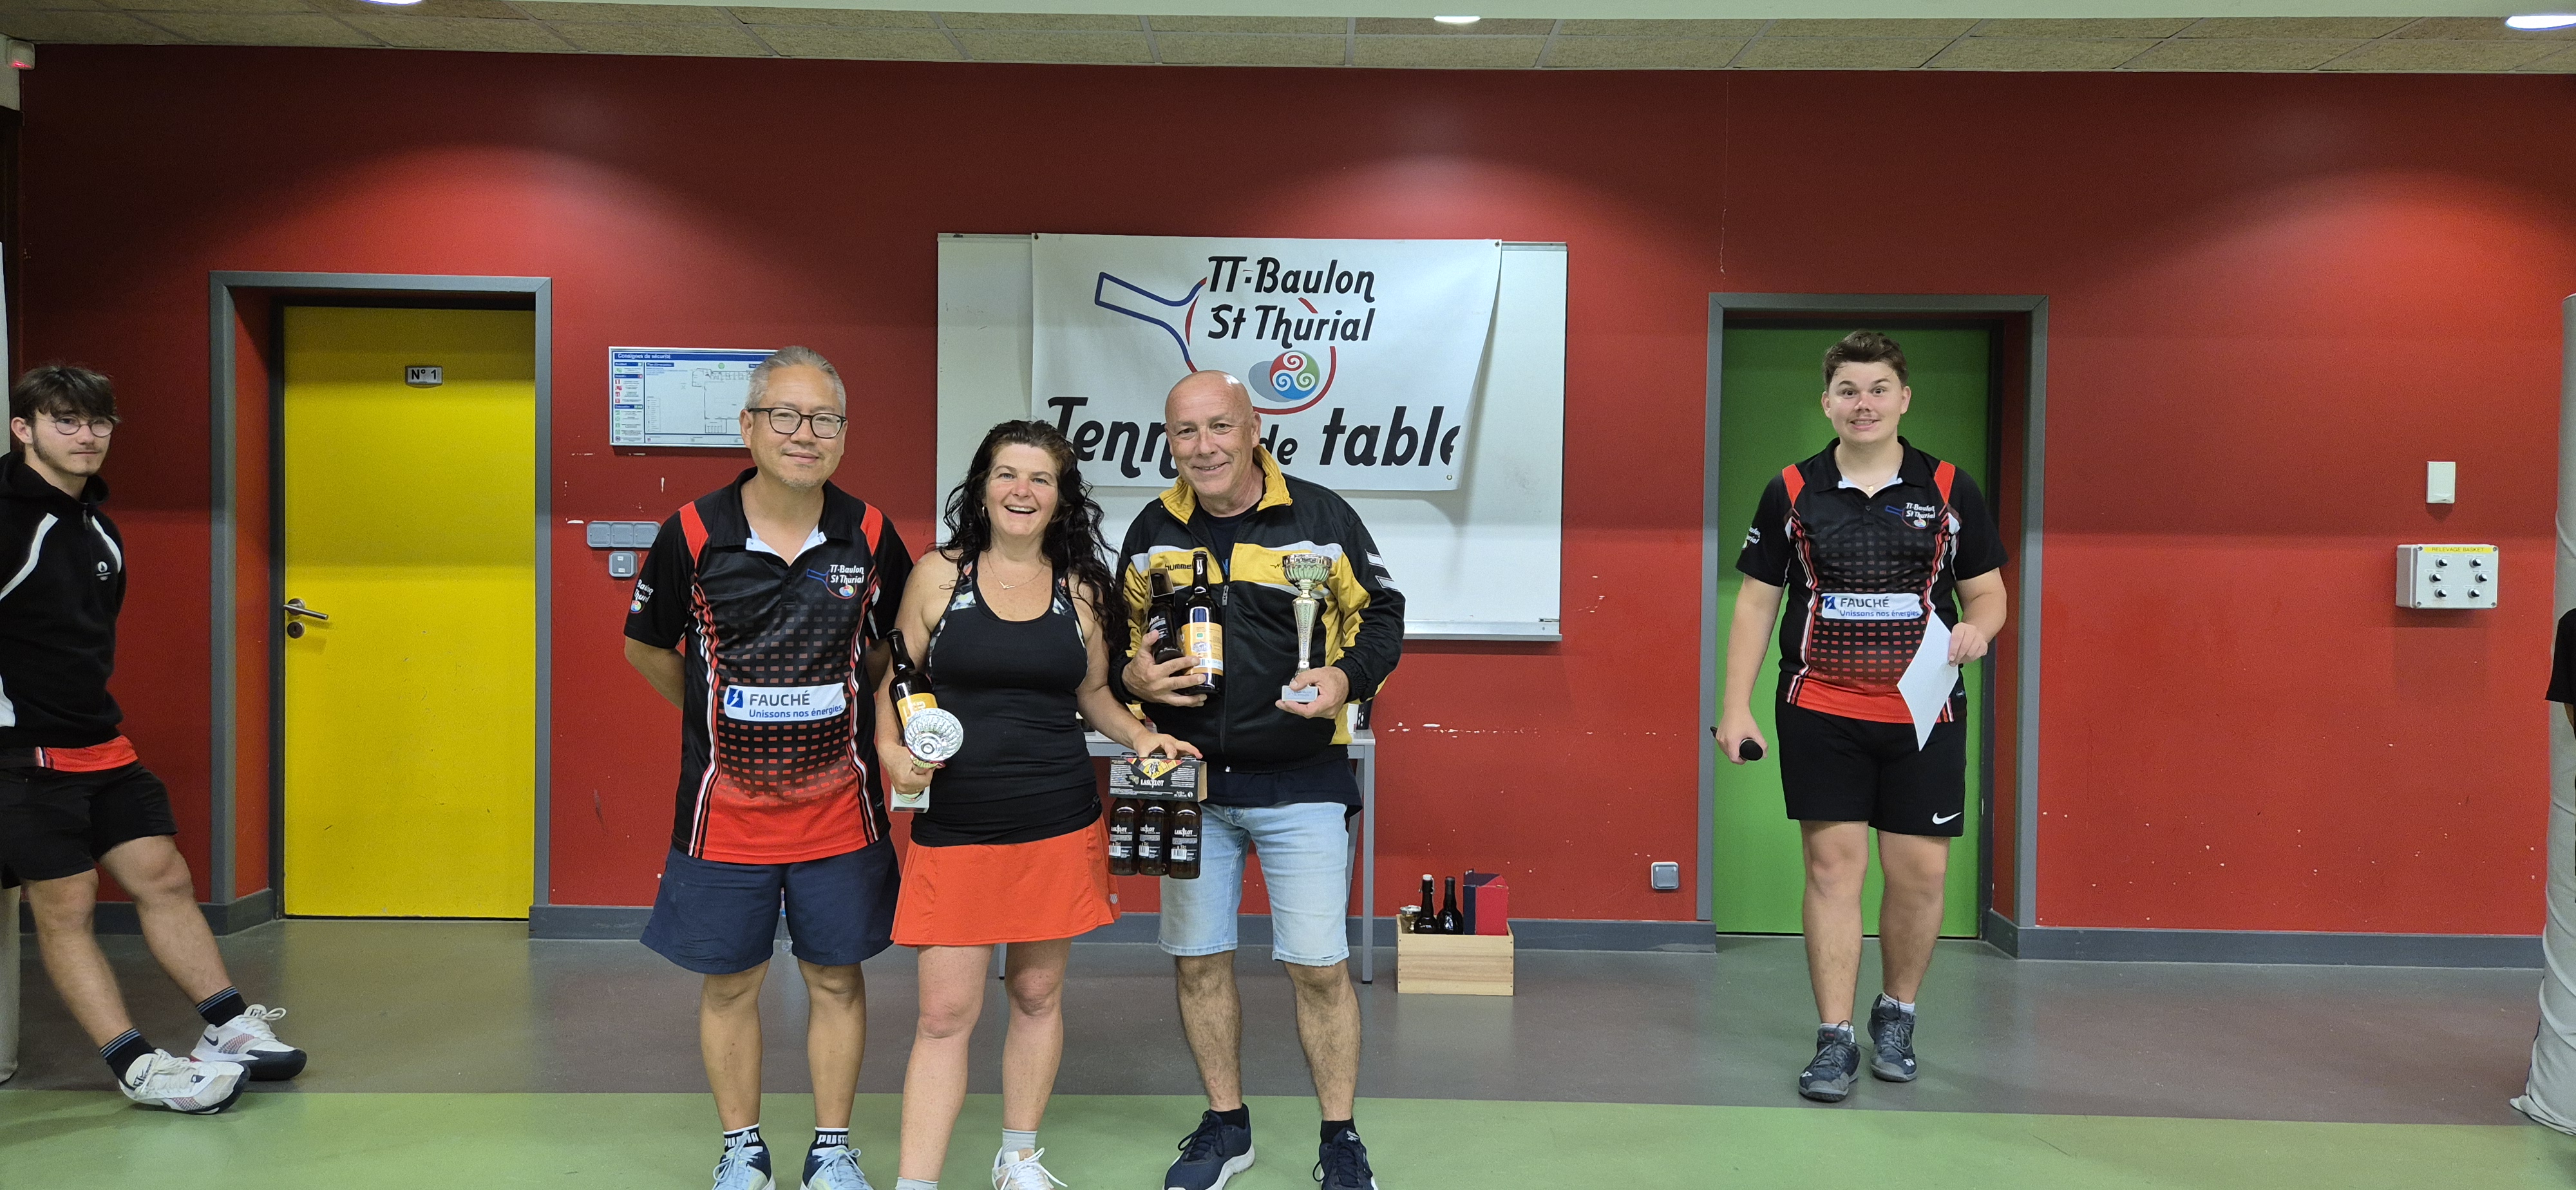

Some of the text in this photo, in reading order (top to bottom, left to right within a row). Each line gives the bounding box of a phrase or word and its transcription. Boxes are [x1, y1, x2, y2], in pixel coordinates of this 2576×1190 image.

[1208, 256, 1376, 303] TT-Baulon
[1208, 303, 1376, 349] St Thurial
[412, 369, 437, 380] N° 1
[1047, 397, 1180, 479] Tenn
[1319, 406, 1461, 467] table
[830, 564, 864, 574] TT-Baulon
[1164, 563, 1194, 571] humme
[830, 574, 864, 585] St Thurial
[1840, 596, 1890, 608] FAUCHÉ
[749, 690, 811, 706] FAUCHÉ
[749, 709, 791, 718] Unissons
[817, 1134, 848, 1145] PUM
